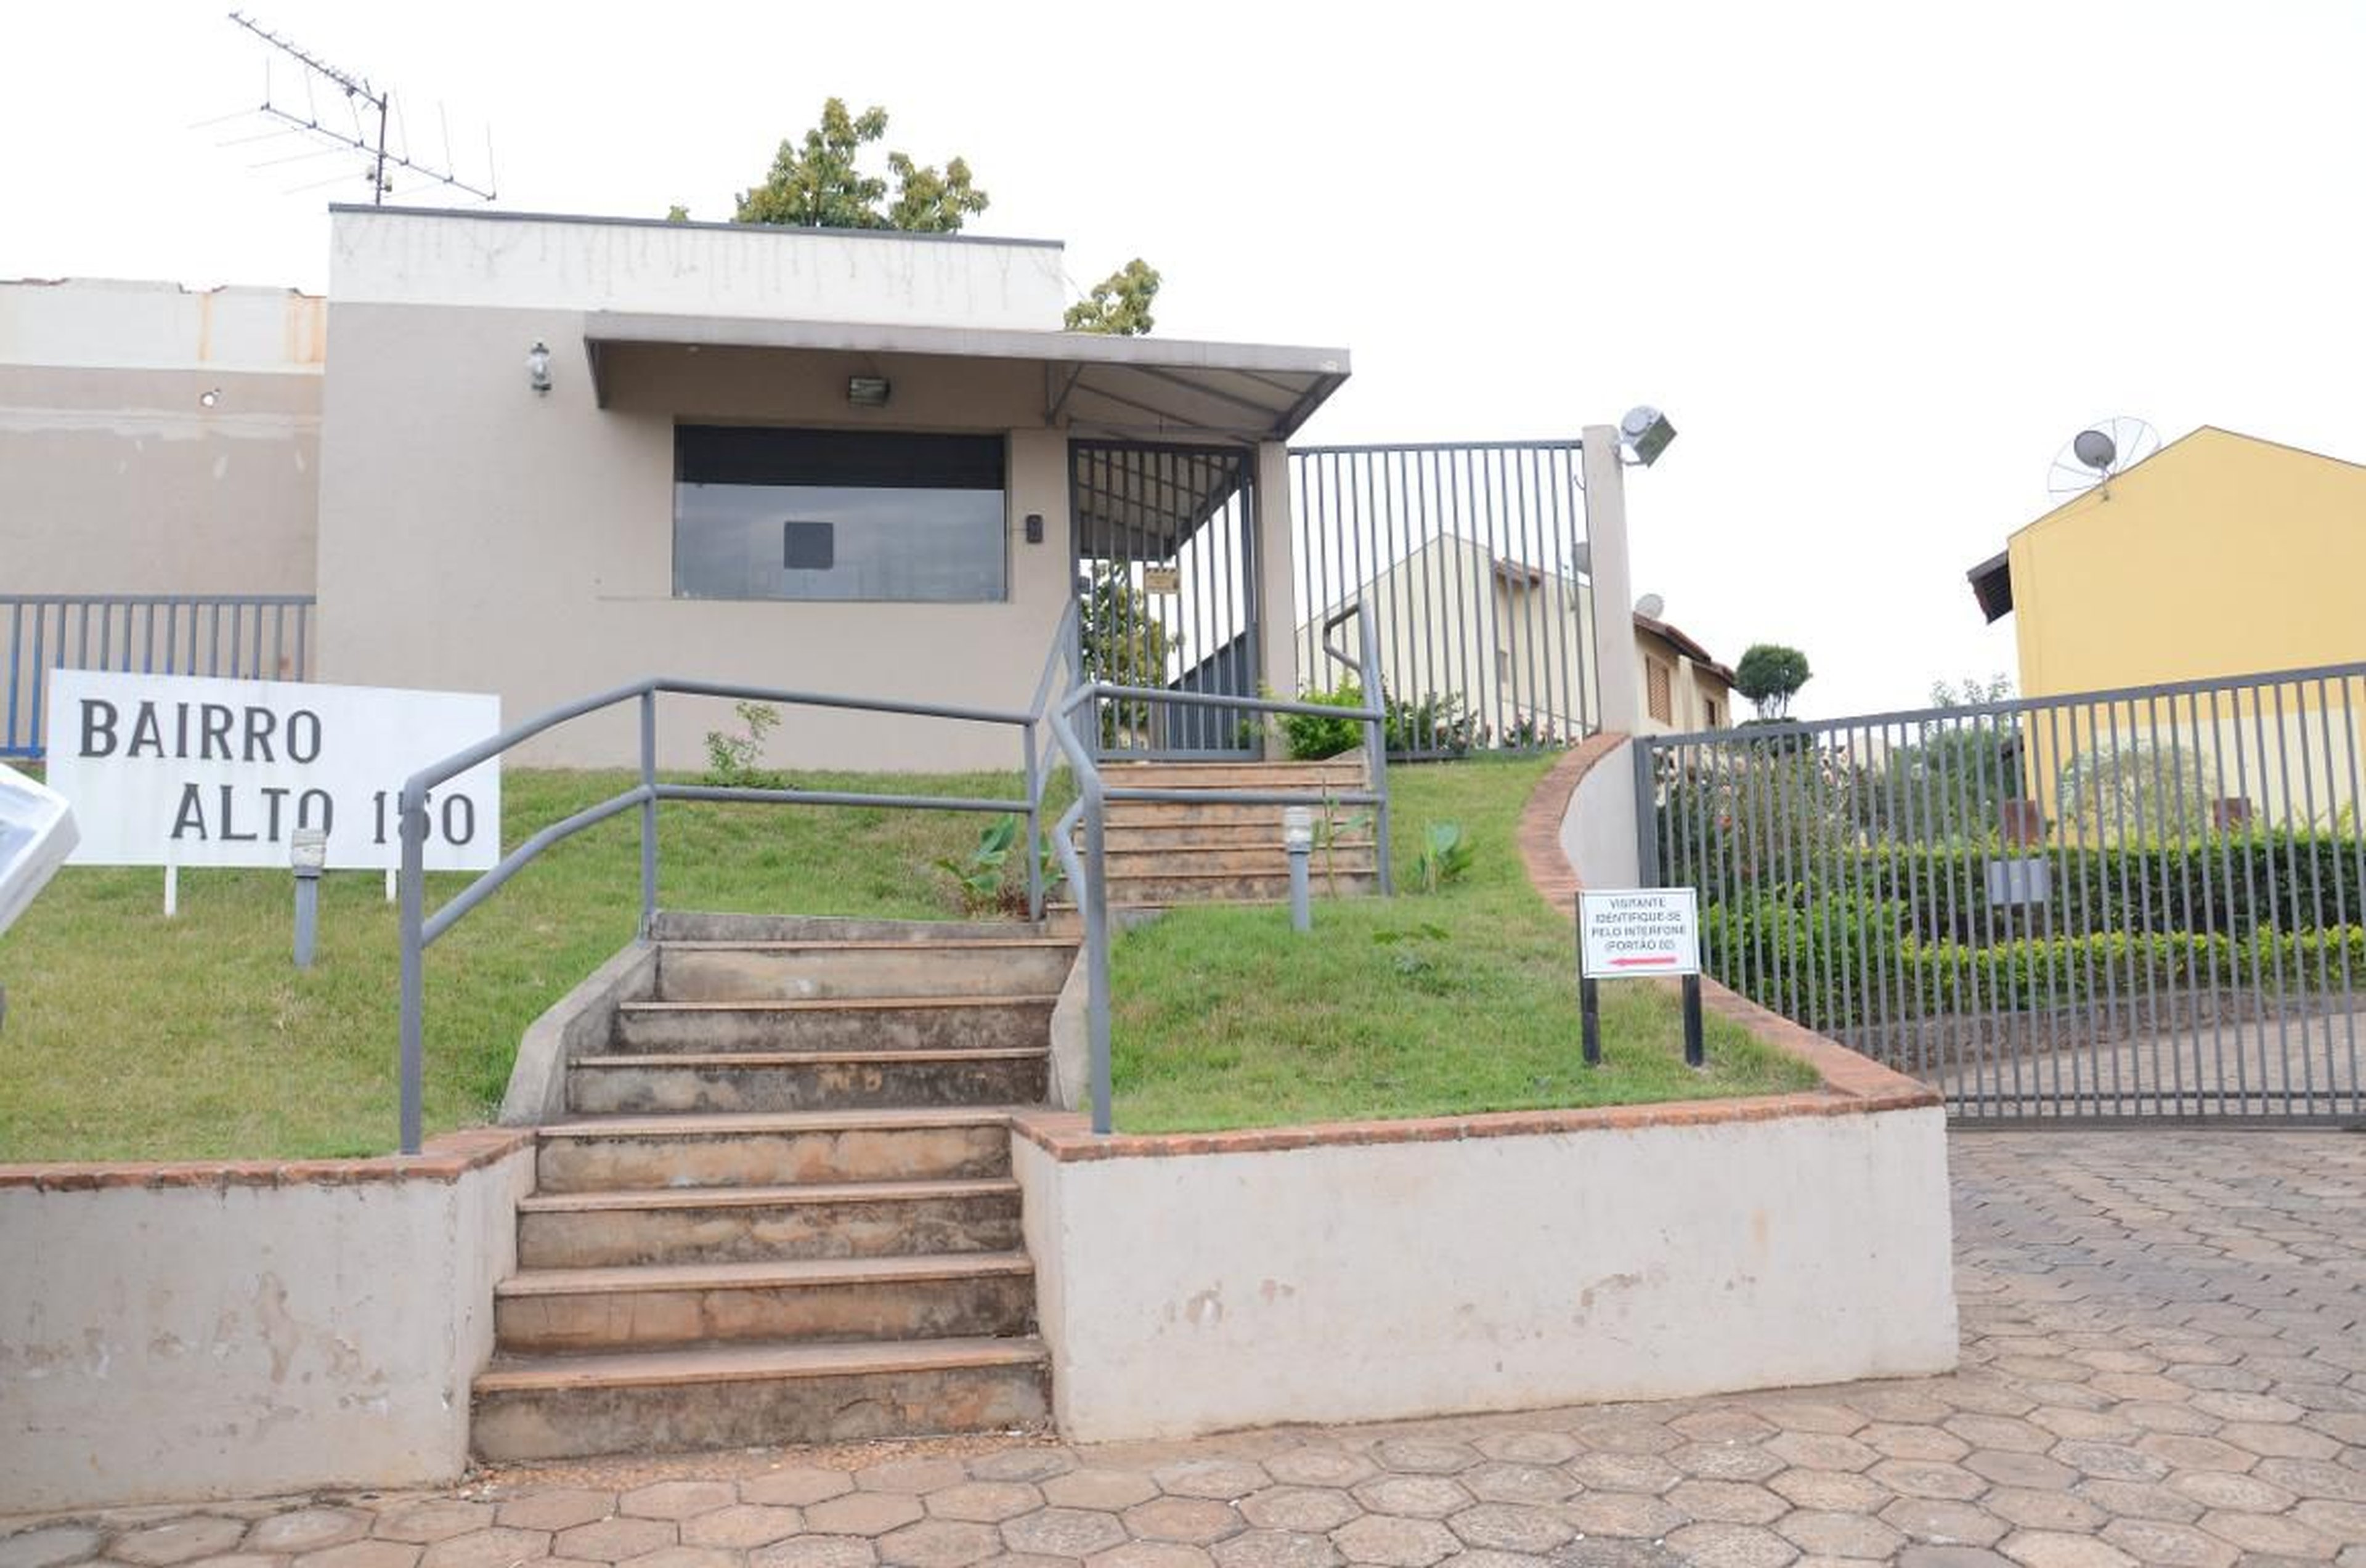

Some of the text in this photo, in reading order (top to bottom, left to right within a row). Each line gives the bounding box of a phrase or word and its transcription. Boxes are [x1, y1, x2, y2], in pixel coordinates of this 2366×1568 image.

[78, 699, 322, 764] BAIRRO
[170, 783, 333, 842] ALTO
[1609, 897, 1666, 909] VISITANTE
[1592, 925, 1686, 938] PELO INTERFONE
